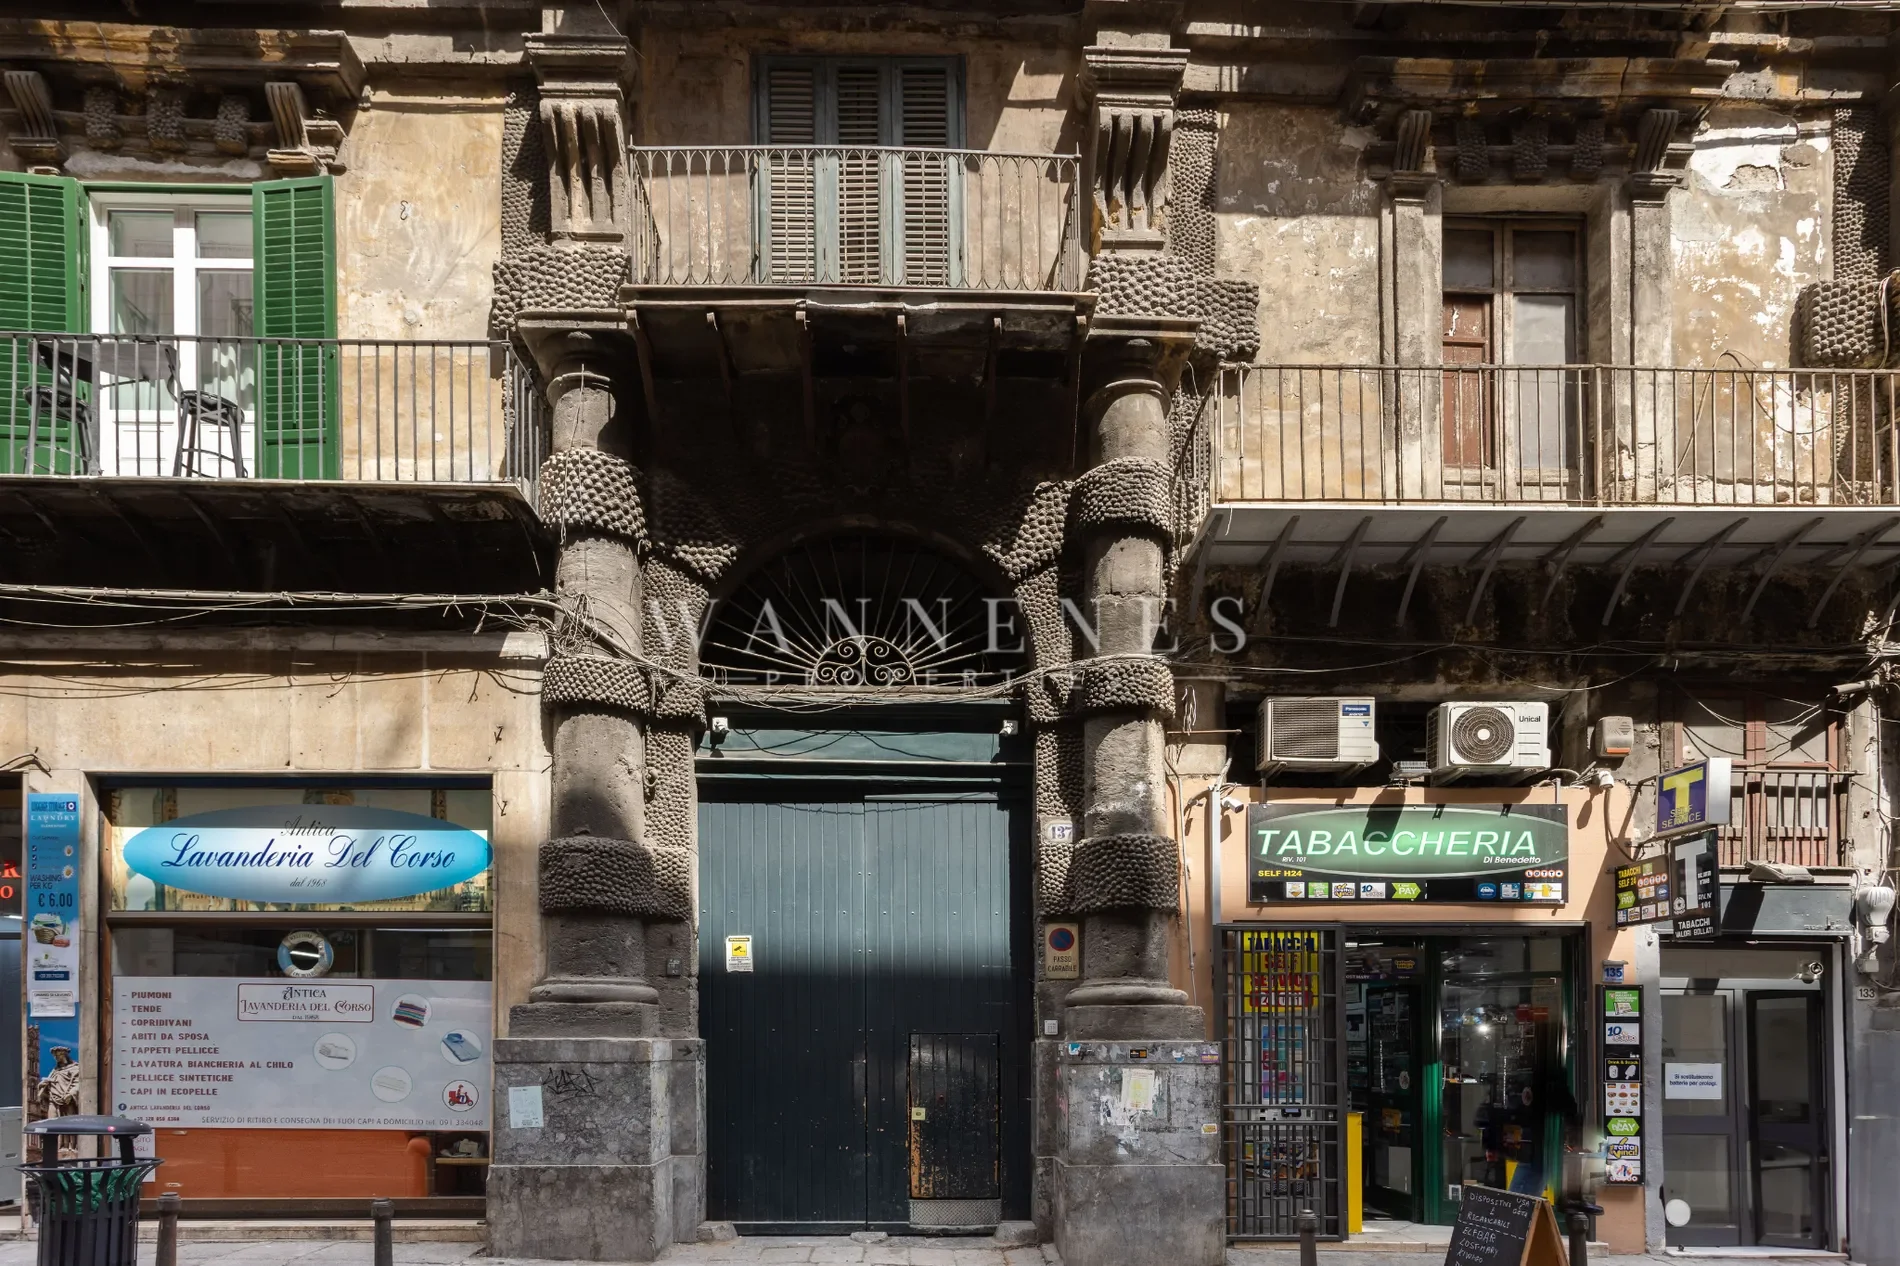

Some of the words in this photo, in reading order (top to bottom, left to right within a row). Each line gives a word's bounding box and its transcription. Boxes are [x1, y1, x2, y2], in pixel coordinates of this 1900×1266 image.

[1518, 715, 1541, 723] Unical
[280, 815, 337, 837] Antica
[1051, 825, 1073, 840] 137
[1257, 830, 1537, 856] TABACCHERIA
[161, 833, 316, 868] Lavanderia
[324, 834, 385, 868] Del
[388, 834, 456, 868] Corso
[1495, 856, 1541, 864] Benedetto
[290, 876, 305, 887] dal
[306, 877, 327, 887] 1968
[1398, 887, 1417, 895] PAY
[39, 892, 45, 907] €
[49, 892, 73, 908] 6.00
[1678, 917, 1711, 930] TABACCHI
[1047, 965, 1077, 973] CARRABILE
[1604, 967, 1623, 977] 135
[131, 991, 172, 999] PIUMONI
[282, 986, 327, 1000] ANTICA
[1859, 989, 1875, 998] 133
[131, 1005, 162, 1013] TENDE
[240, 1000, 307, 1014] LAVANDERIA
[309, 1003, 330, 1011] DEL
[334, 1000, 371, 1014] CORSO
[131, 1019, 192, 1027] COPRIDIVANI
[1607, 1026, 1622, 1036] 10
[130, 1060, 183, 1068] LAVATURA
[187, 1060, 245, 1068] BIANCHERIA
[266, 1061, 294, 1069] CHILO
[130, 1074, 174, 1082] PELLICCE
[179, 1074, 234, 1082] SINTETICHE
[130, 1088, 152, 1096] CAPI
[157, 1088, 167, 1096] IN
[171, 1088, 218, 1096] ECOPELLE
[247, 1116, 272, 1124] RITIRO
